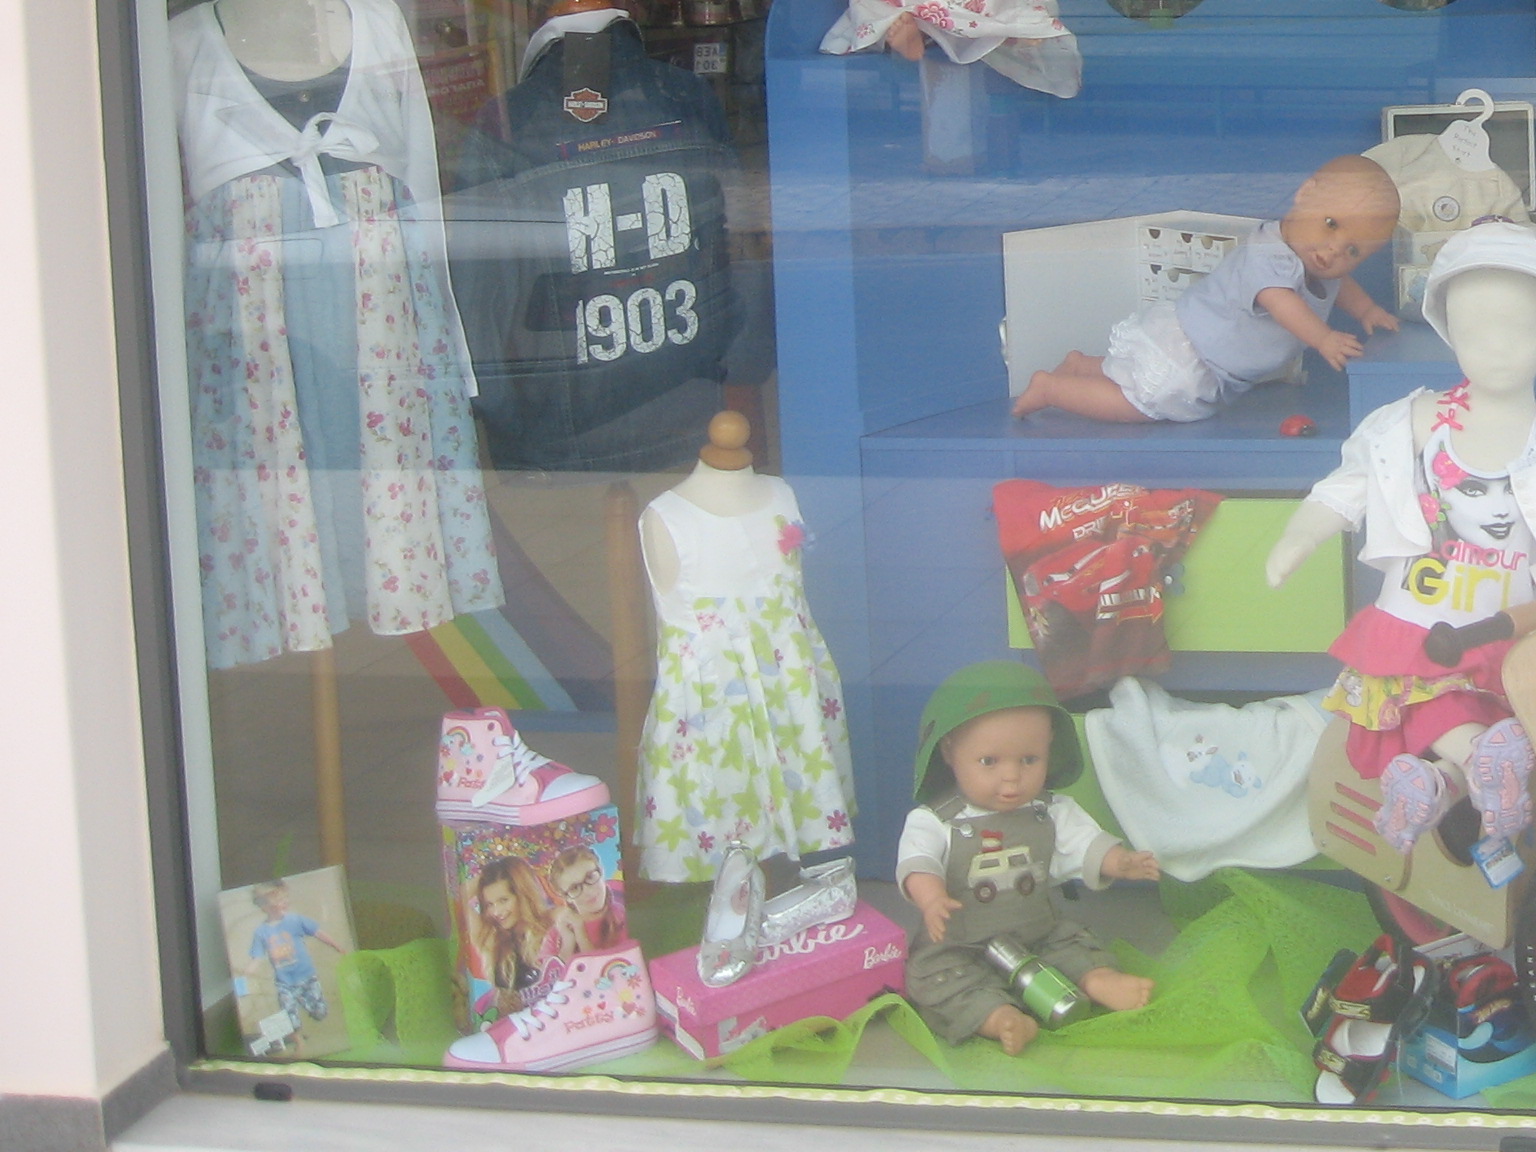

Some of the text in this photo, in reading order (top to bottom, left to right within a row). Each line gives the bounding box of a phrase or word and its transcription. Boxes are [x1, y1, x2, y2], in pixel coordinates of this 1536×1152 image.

[562, 172, 692, 275] H-D
[575, 279, 699, 366] 1903
[755, 922, 865, 966] arbie
[863, 942, 902, 970] Barbie
